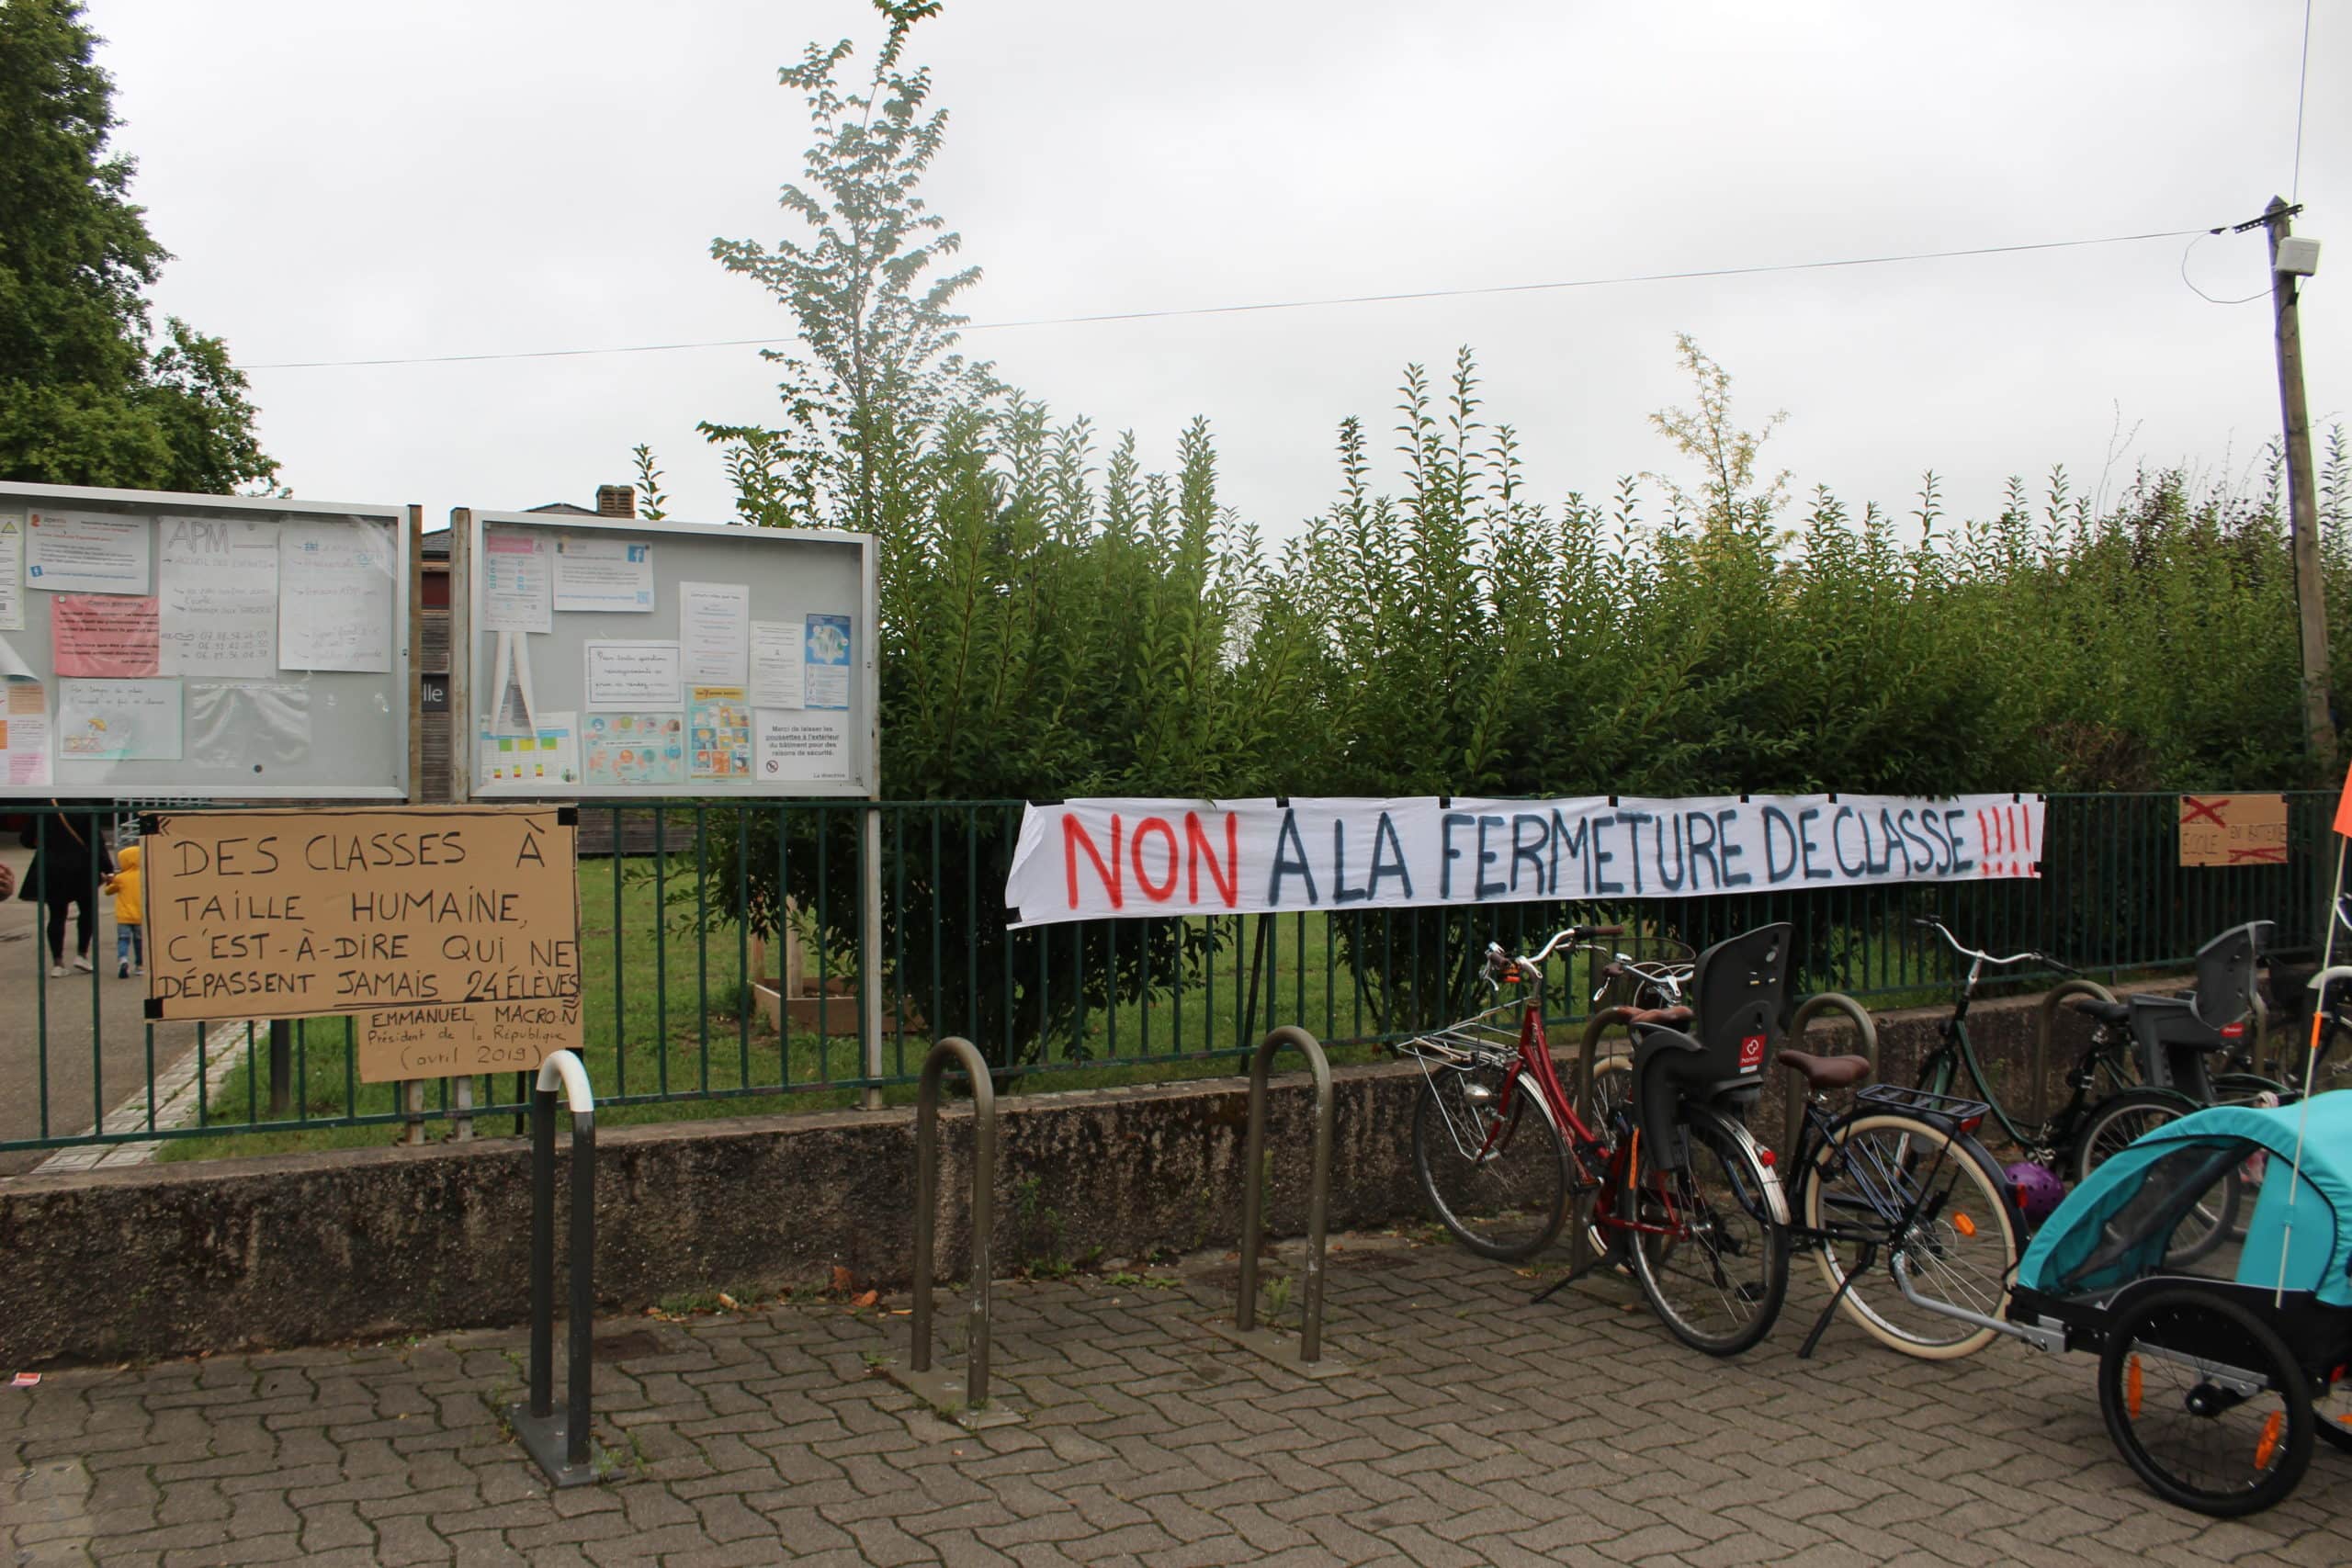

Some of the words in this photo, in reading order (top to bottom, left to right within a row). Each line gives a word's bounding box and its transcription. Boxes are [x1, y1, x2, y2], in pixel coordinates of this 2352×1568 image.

[168, 521, 230, 553] APM
[174, 836, 278, 877] DES
[306, 831, 466, 873] CLASSES
[516, 818, 545, 868] À
[1062, 810, 1238, 911] NON
[1268, 807, 1317, 907] A
[1334, 811, 1413, 905] LA
[1441, 808, 1752, 900] FERMETURE
[1762, 806, 1832, 884] DE
[530, 938, 575, 967] NE
[156, 966, 316, 1000] DÉPASSENT
[464, 970, 498, 1001] 24
[506, 965, 580, 1000] ÉLÈVES
[371, 1007, 475, 1028] EMMANUEL
[495, 1006, 577, 1025] MACRON
[368, 1028, 425, 1044] Président
[438, 1027, 456, 1040] de
[472, 1027, 482, 1041] la
[493, 1024, 567, 1044] République
